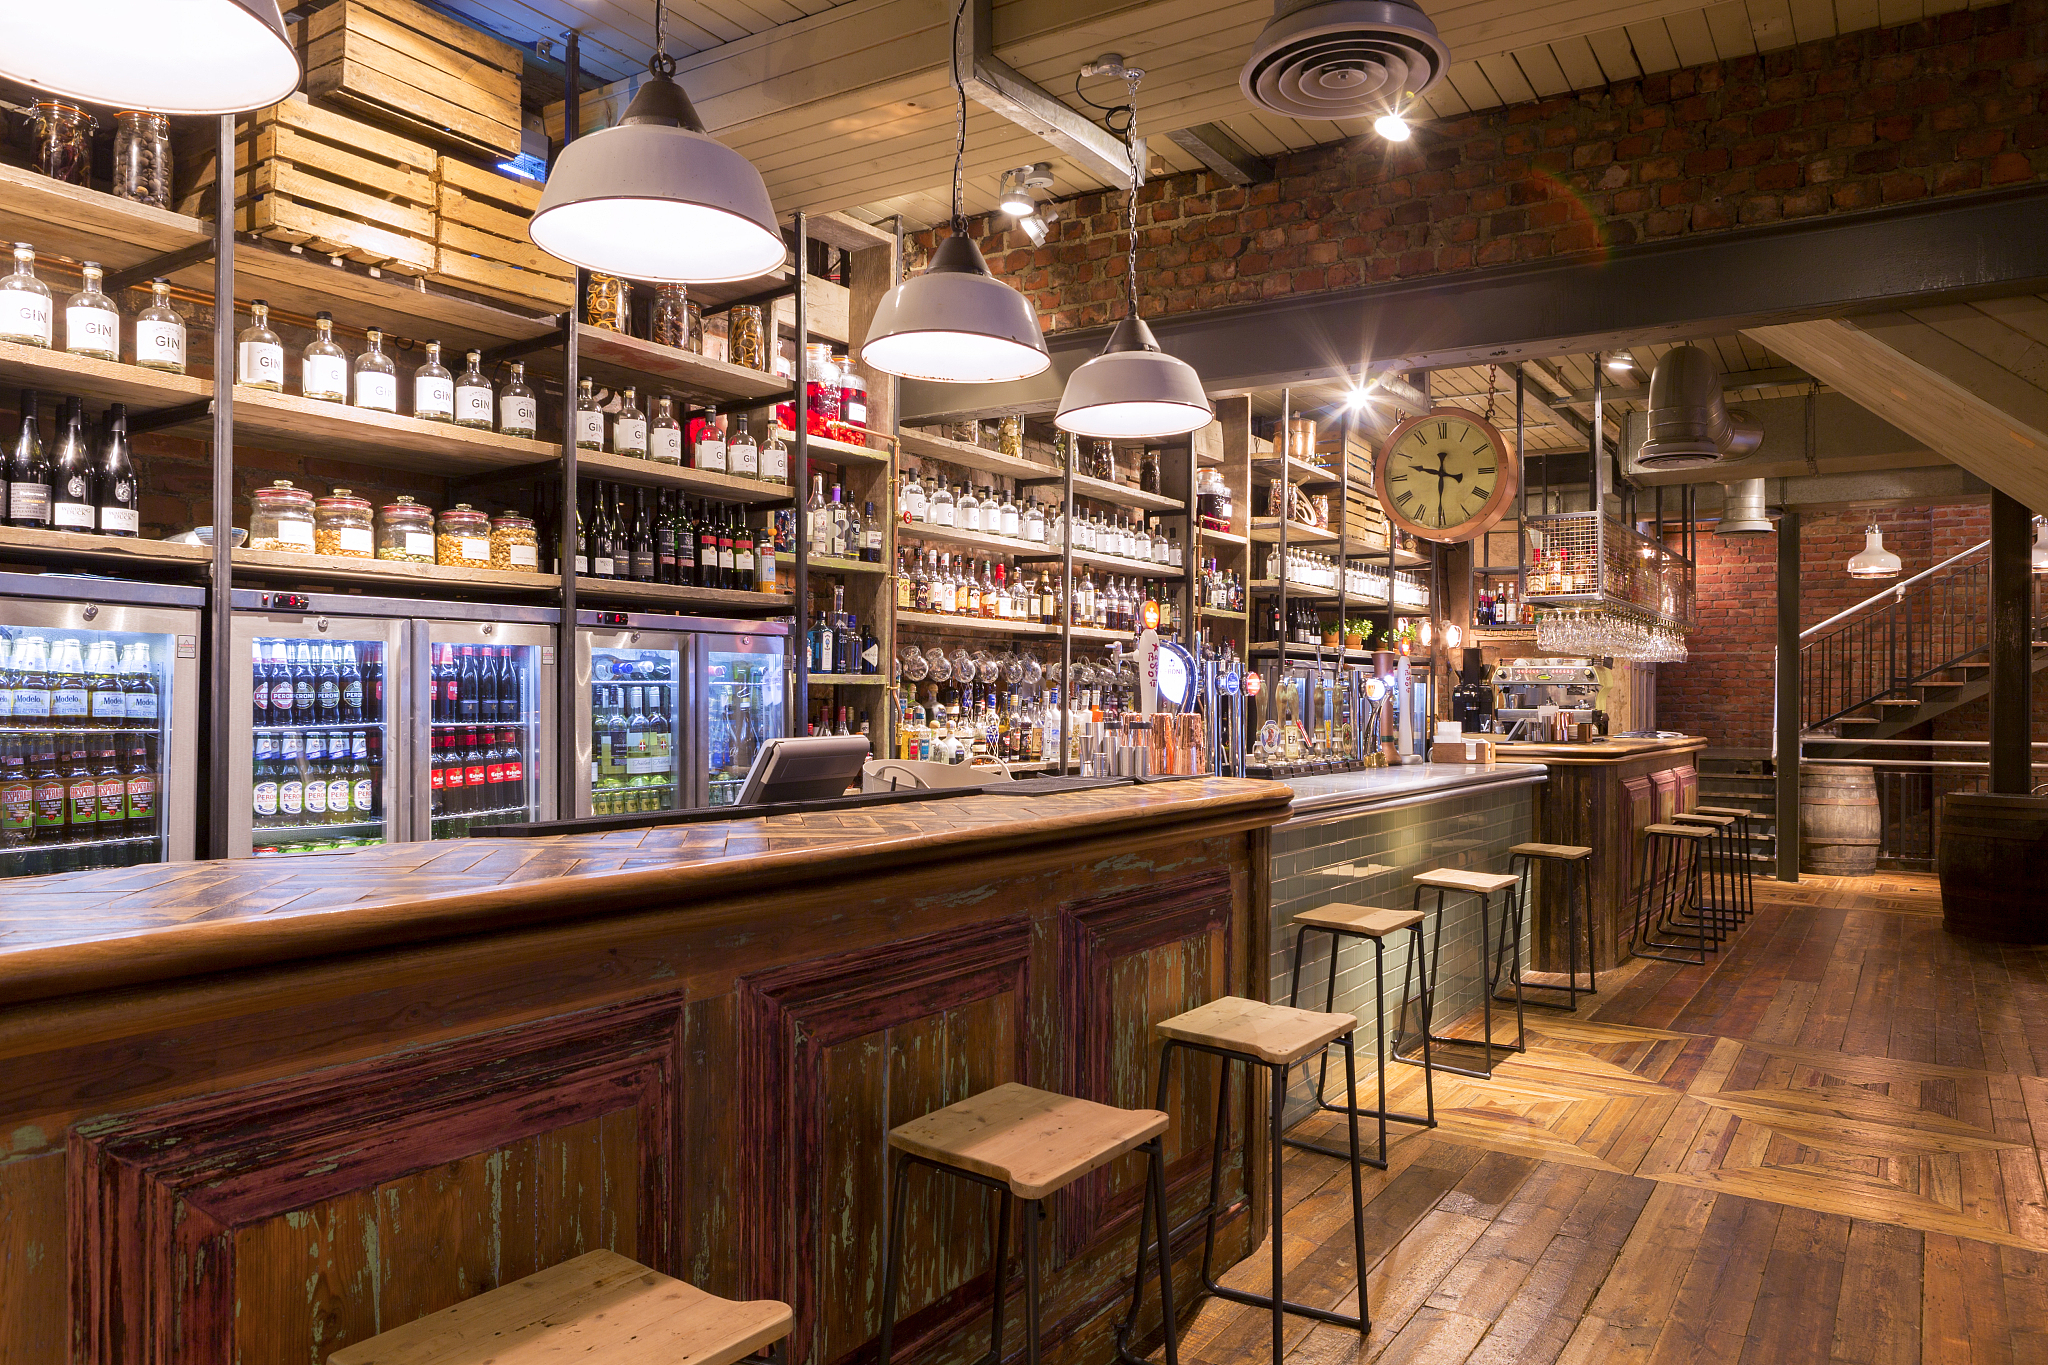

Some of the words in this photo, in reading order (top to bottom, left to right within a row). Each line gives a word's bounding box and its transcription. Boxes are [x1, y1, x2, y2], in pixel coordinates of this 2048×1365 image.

[20, 307, 47, 324] GIN
[85, 322, 112, 338] GIN
[155, 335, 180, 350] GIN
[259, 356, 281, 371] GIN
[433, 389, 451, 402] GIN
[471, 398, 490, 410] GIN
[518, 408, 535, 419] GIN
[16, 694, 41, 703] Modelo
[55, 694, 79, 703] Modelo
